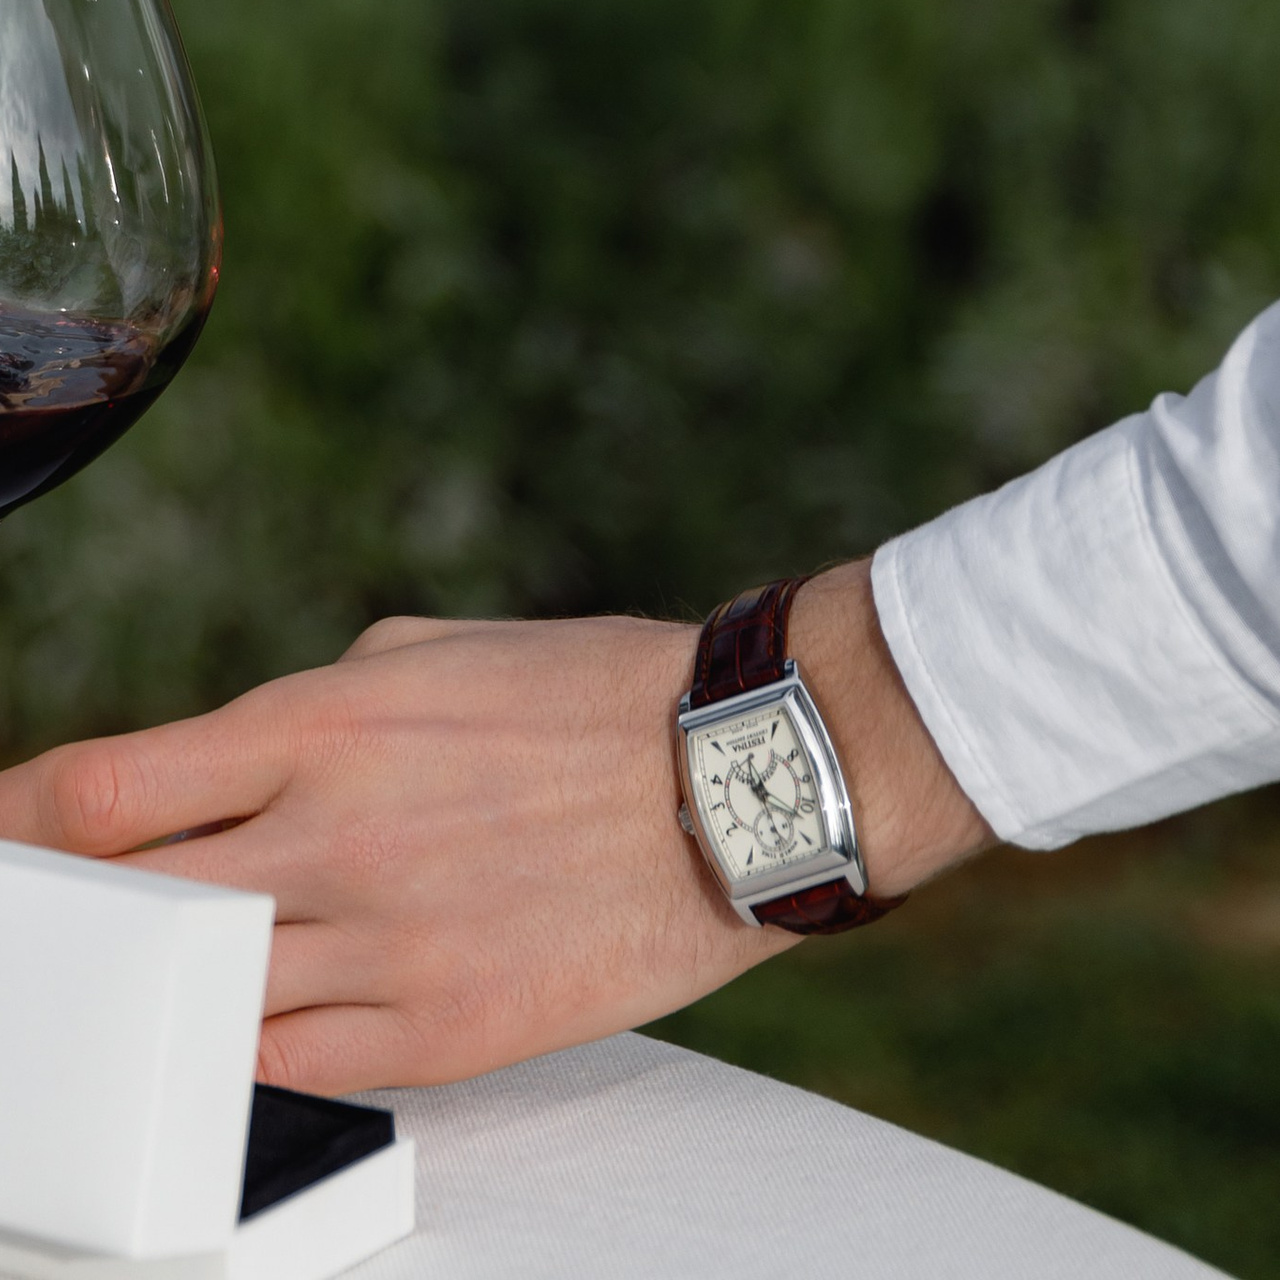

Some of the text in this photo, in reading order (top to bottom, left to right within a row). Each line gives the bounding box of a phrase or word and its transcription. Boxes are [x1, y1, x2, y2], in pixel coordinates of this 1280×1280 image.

[731, 736, 766, 753] FESTINA
[786, 749, 800, 763] 8
[710, 774, 723, 786] 4
[712, 802, 725, 812] 3
[800, 797, 816, 814] 10
[726, 822, 739, 837] 2
